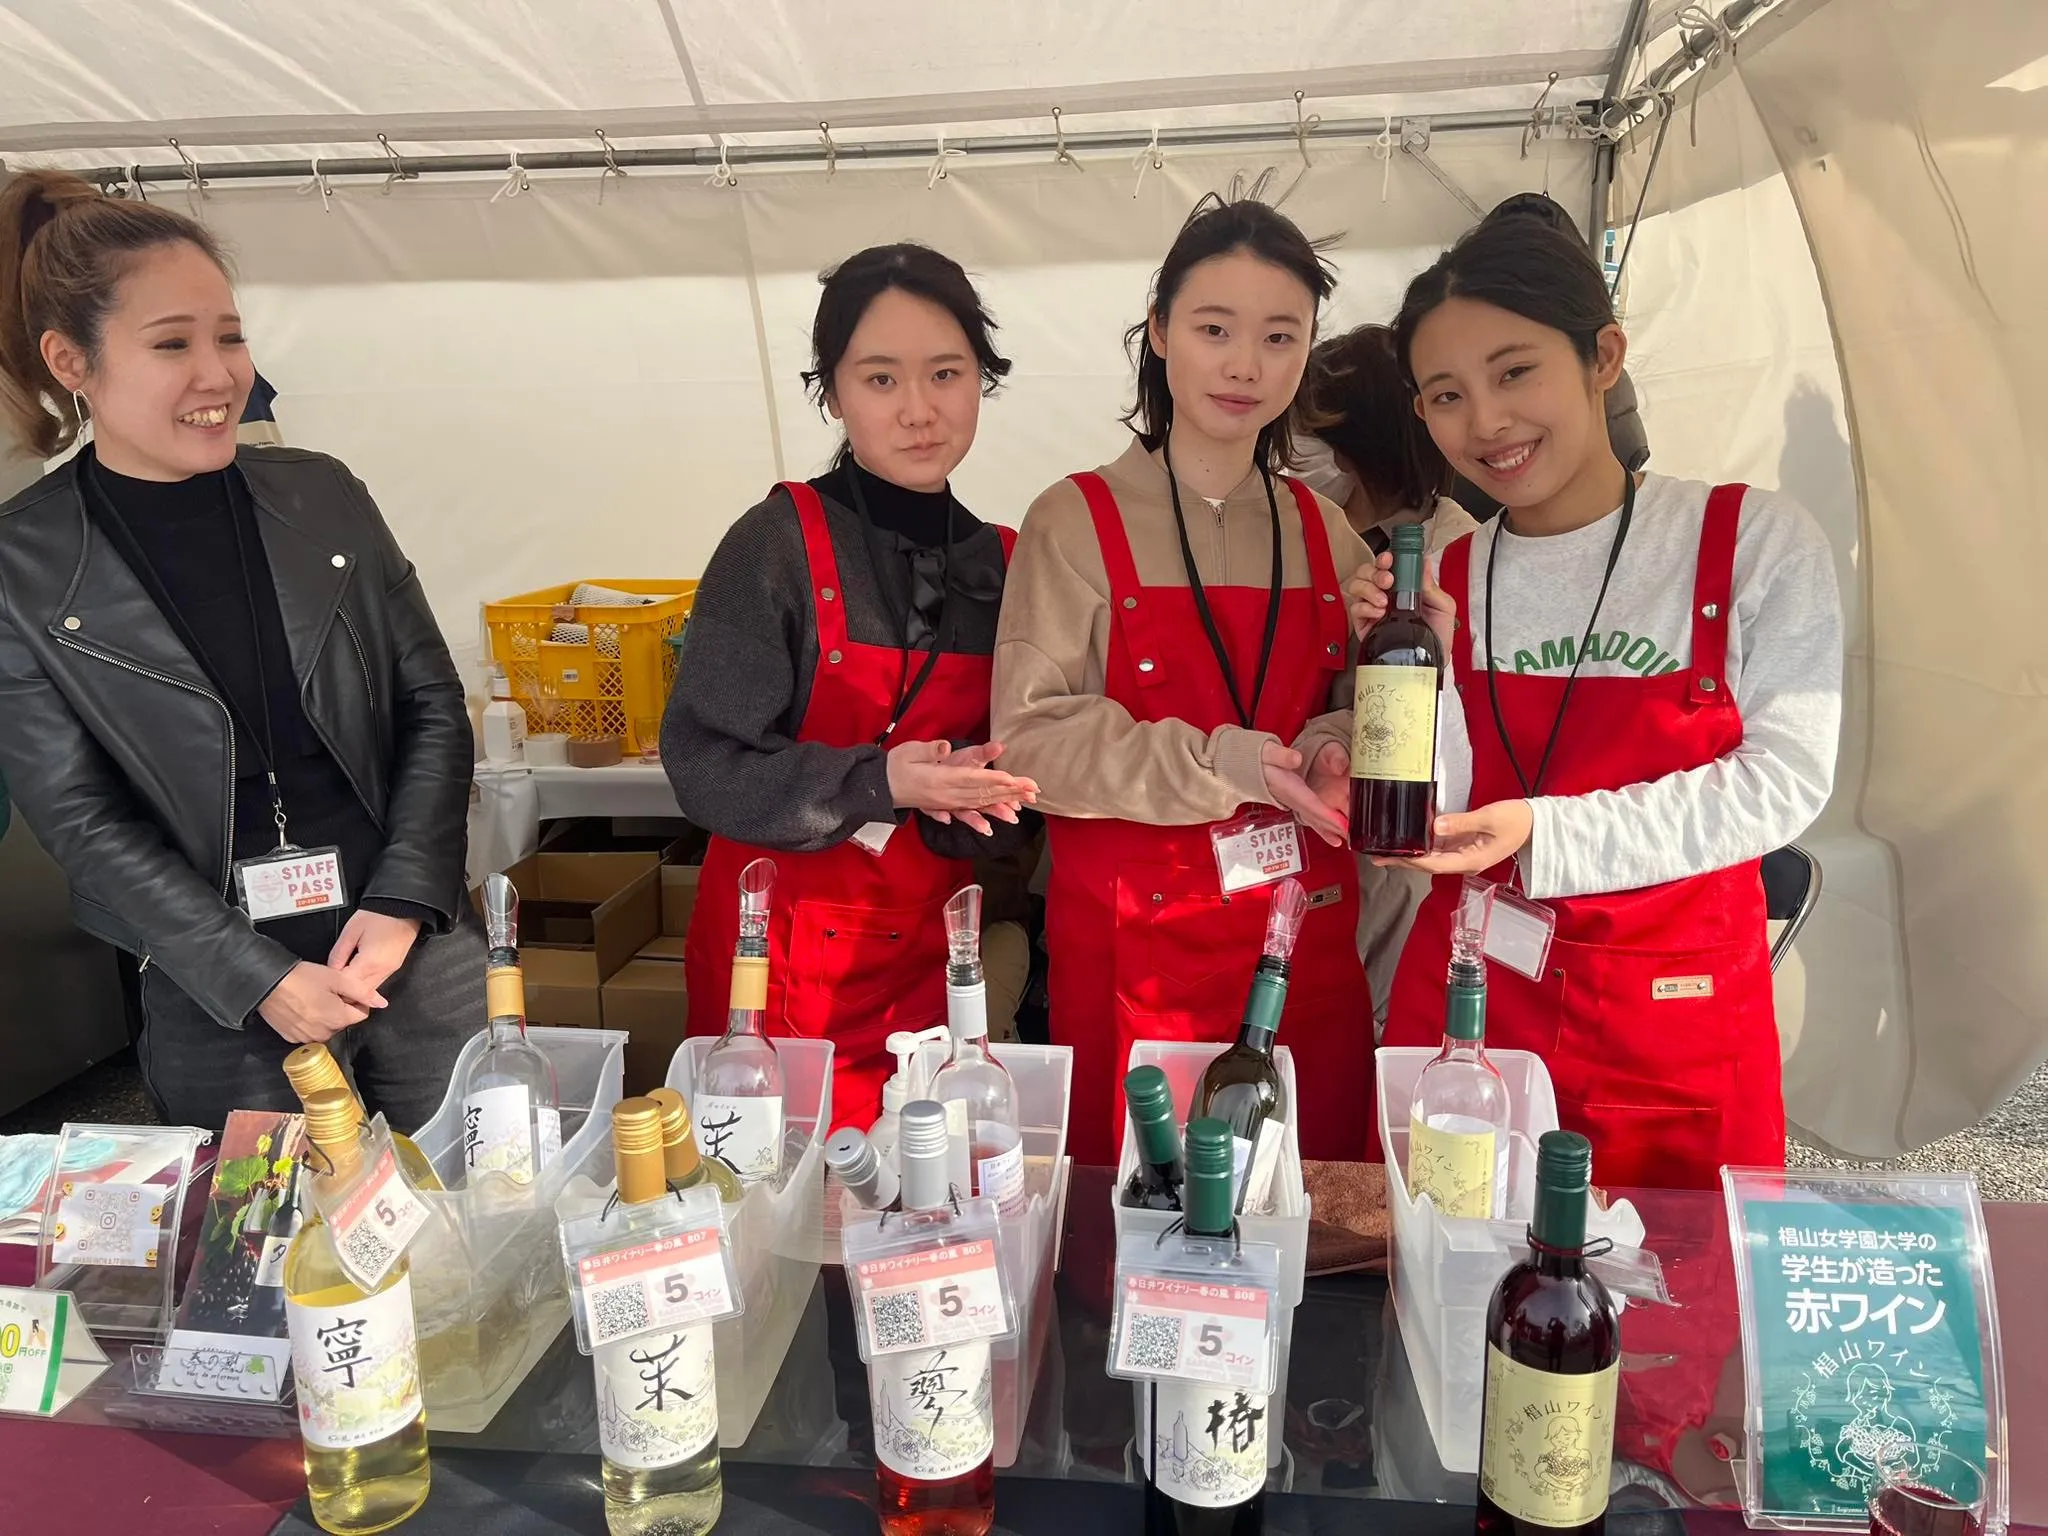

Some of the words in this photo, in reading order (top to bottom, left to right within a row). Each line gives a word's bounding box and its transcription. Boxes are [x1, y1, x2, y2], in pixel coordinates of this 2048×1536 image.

[1250, 826, 1294, 848] STAFF
[1256, 844, 1293, 864] PASS
[281, 860, 334, 881] STAFF
[288, 878, 334, 897] PASS
[375, 1199, 396, 1227] 5
[1778, 1226, 1937, 1251] 椙山女学園大学の
[1781, 1254, 1944, 1287] 学生が造った
[664, 1272, 689, 1303] 5
[693, 1287, 721, 1301] コイン
[939, 1284, 963, 1317] 5
[968, 1304, 996, 1317] コイン
[1785, 1287, 1947, 1336] 赤ワイン
[316, 1317, 373, 1389] 寧
[1198, 1323, 1223, 1356] 5
[1225, 1351, 1255, 1365] コイン
[1812, 1339, 1930, 1379] 椙山ワイン
